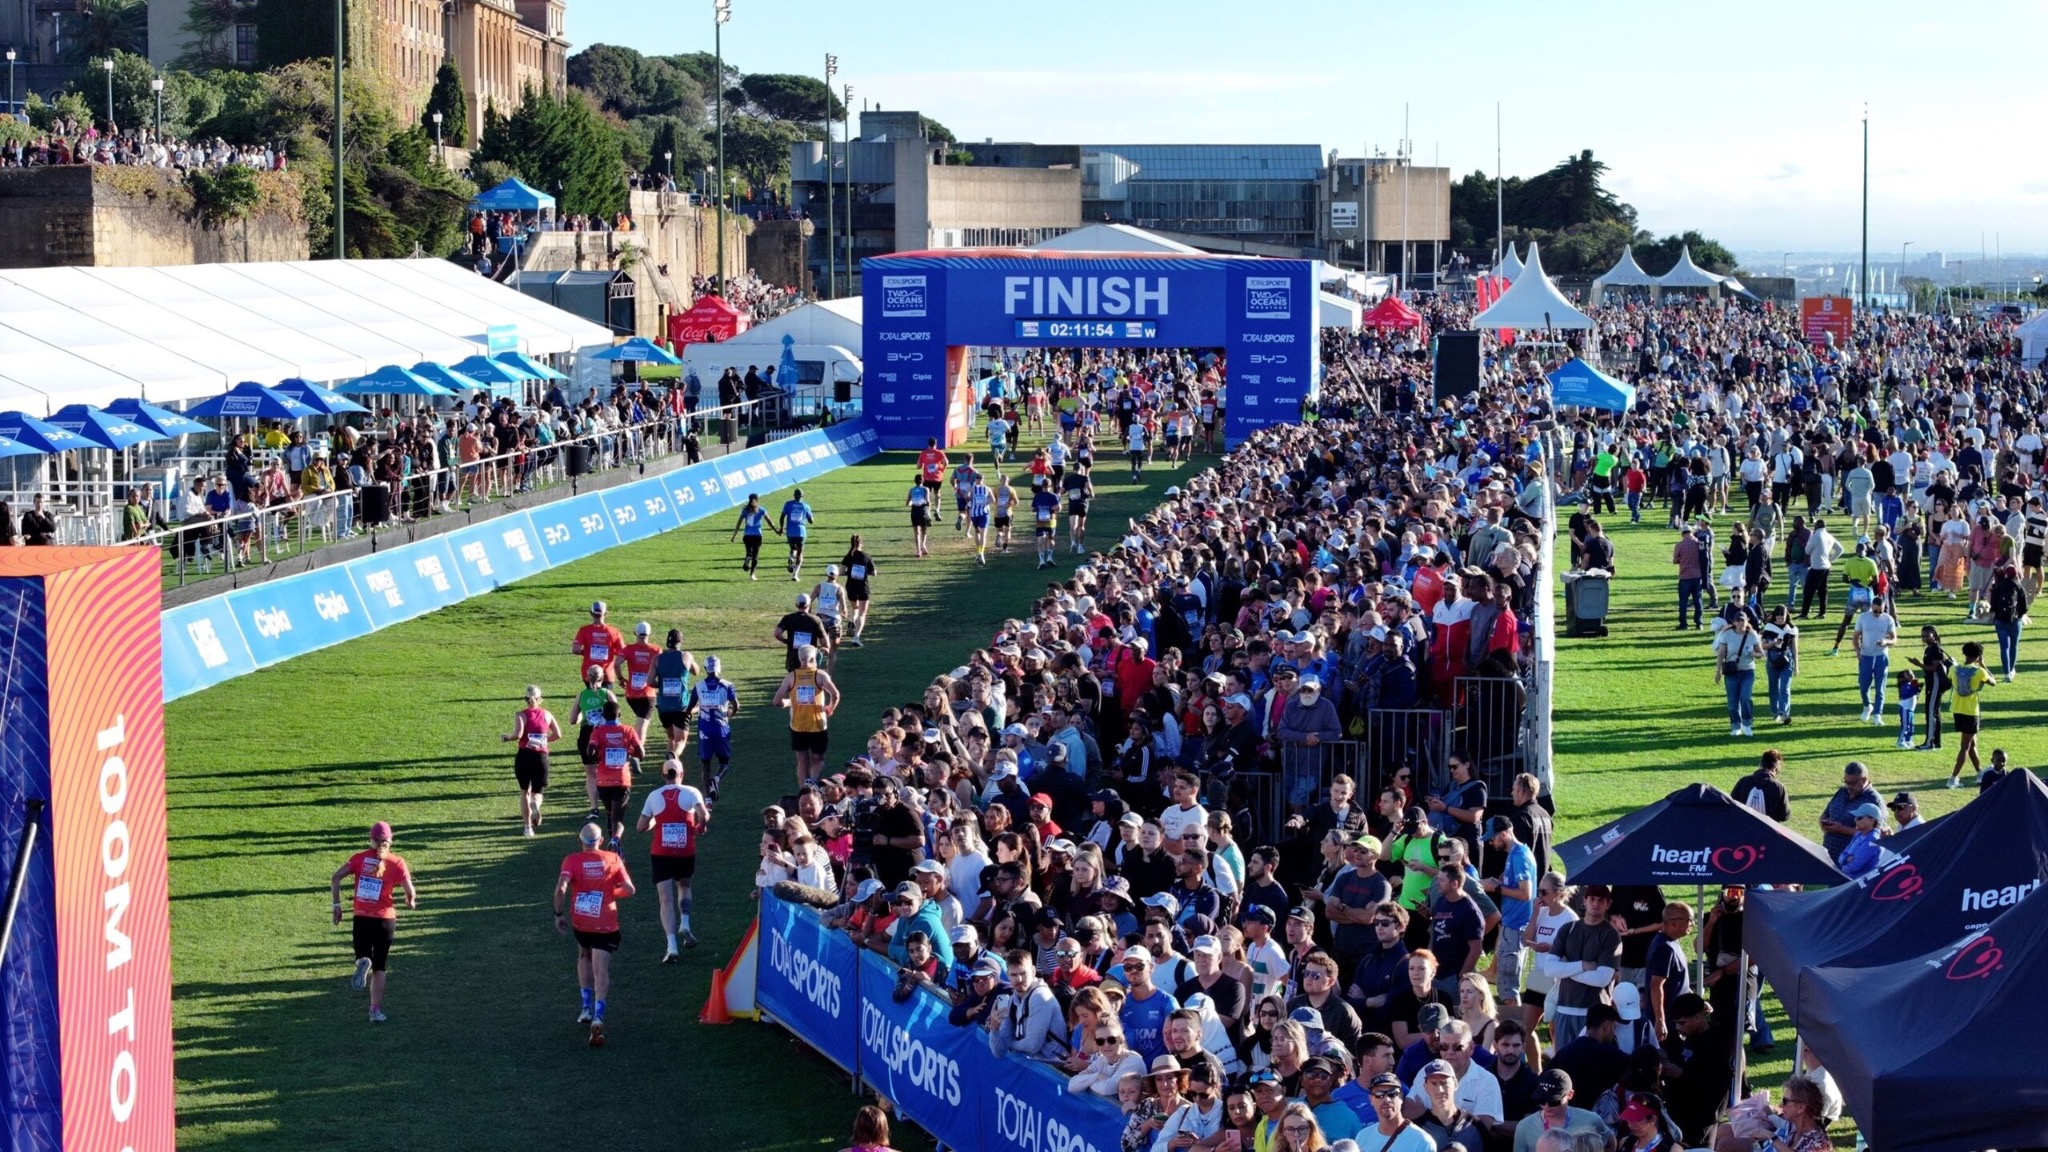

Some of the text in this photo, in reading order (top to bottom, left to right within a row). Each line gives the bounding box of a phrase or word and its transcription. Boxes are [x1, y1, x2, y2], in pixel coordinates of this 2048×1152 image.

[887, 296, 924, 304] OCEANS
[1004, 276, 1169, 315] FINISH
[1250, 298, 1287, 306] OCEANS
[1823, 300, 1833, 311] B
[879, 332, 931, 340] TOTALSPORTS
[1050, 323, 1114, 336] 02:11:54
[1242, 334, 1295, 343] TOTALSPORTS
[887, 352, 924, 361] BYD
[1250, 354, 1287, 363] BYD
[912, 373, 932, 381] Cipla
[1276, 376, 1296, 384] Cipla
[157, 416, 188, 427] BYD
[44, 430, 73, 441] BYD
[107, 424, 139, 436] BYD
[701, 478, 721, 496] BYD
[673, 486, 696, 506] BYD
[644, 496, 667, 516] BYD
[613, 505, 637, 525] BYD
[580, 513, 604, 534] BYD
[543, 523, 571, 546] BYD
[313, 590, 350, 622] Cipla
[253, 606, 293, 640] Cipla
[1651, 844, 1711, 864] heart
[1689, 864, 1707, 872] FM
[590, 904, 599, 912] 60
[771, 927, 842, 1019] TOTALSPORTS
[108, 986, 137, 1123] TO
[861, 997, 961, 1106] TOTALSPORTS
[995, 1087, 1101, 1152] TOTALSP
